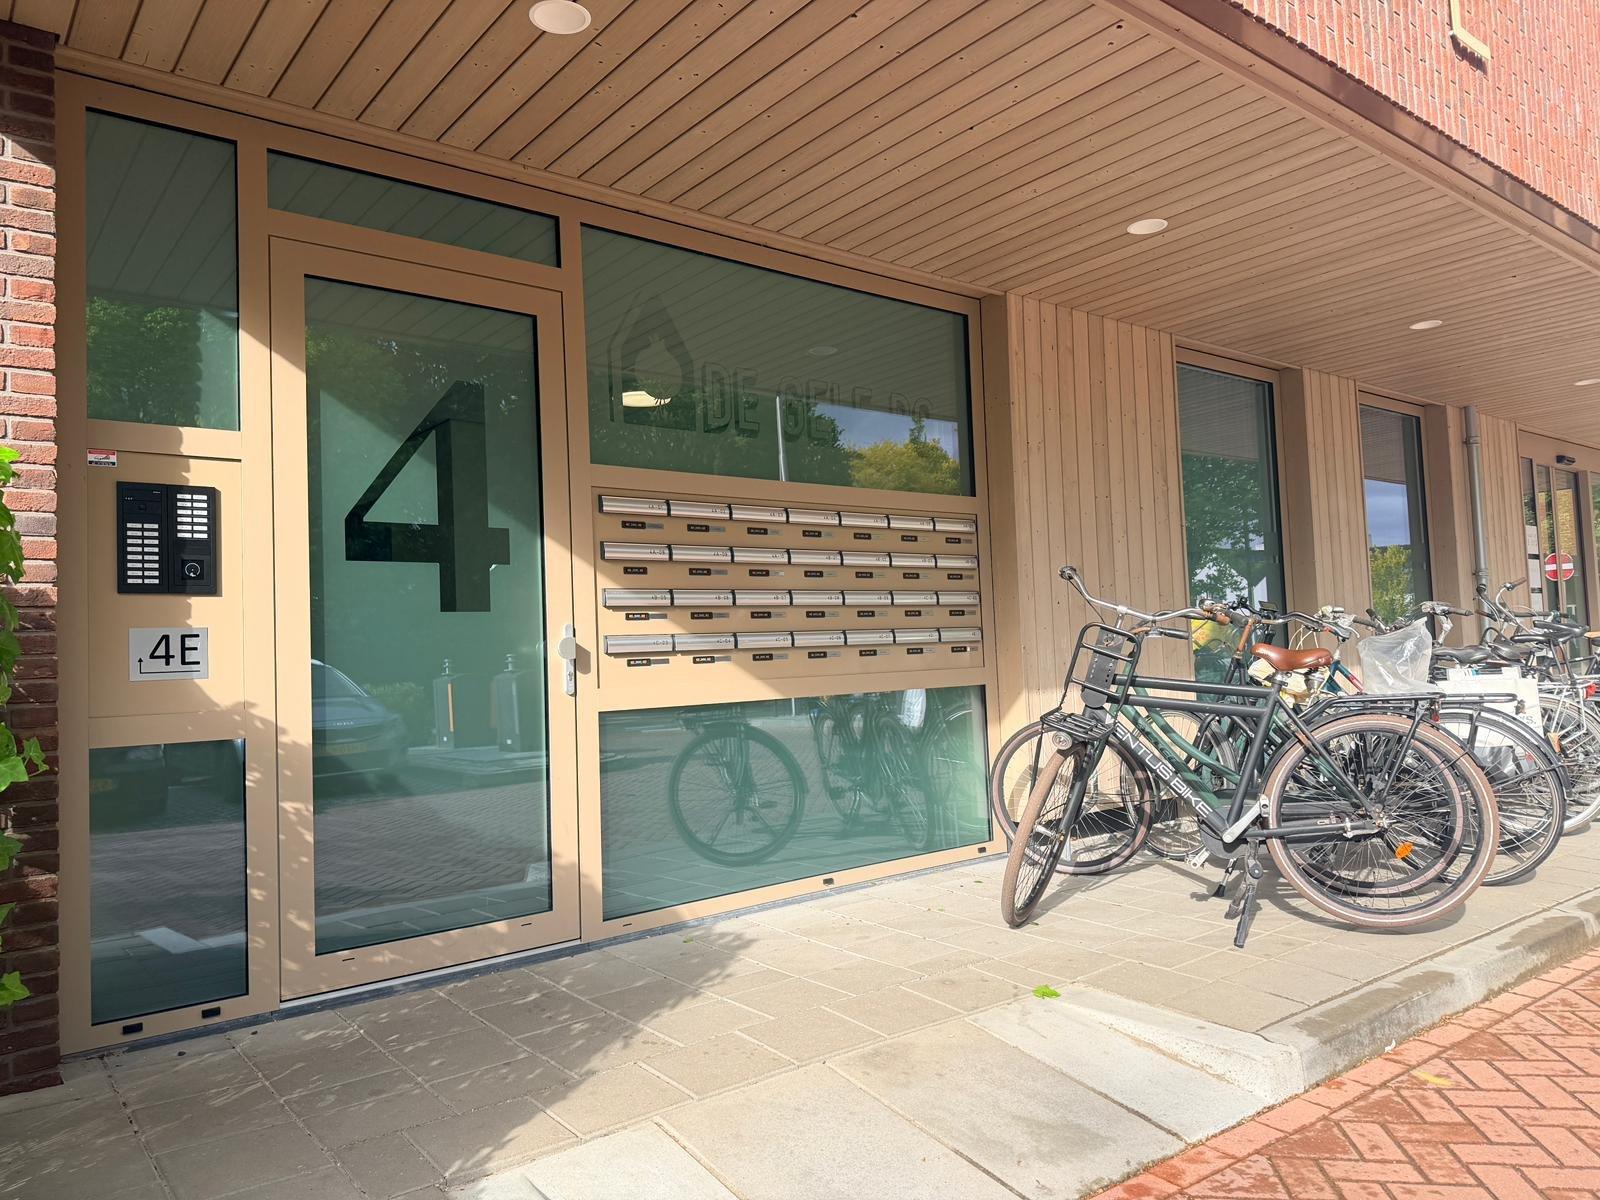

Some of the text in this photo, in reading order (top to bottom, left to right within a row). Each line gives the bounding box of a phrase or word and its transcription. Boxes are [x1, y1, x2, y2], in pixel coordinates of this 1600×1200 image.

[345, 380, 510, 612] 4
[149, 634, 200, 666] 4E
[1170, 777, 1213, 818] BIKE
